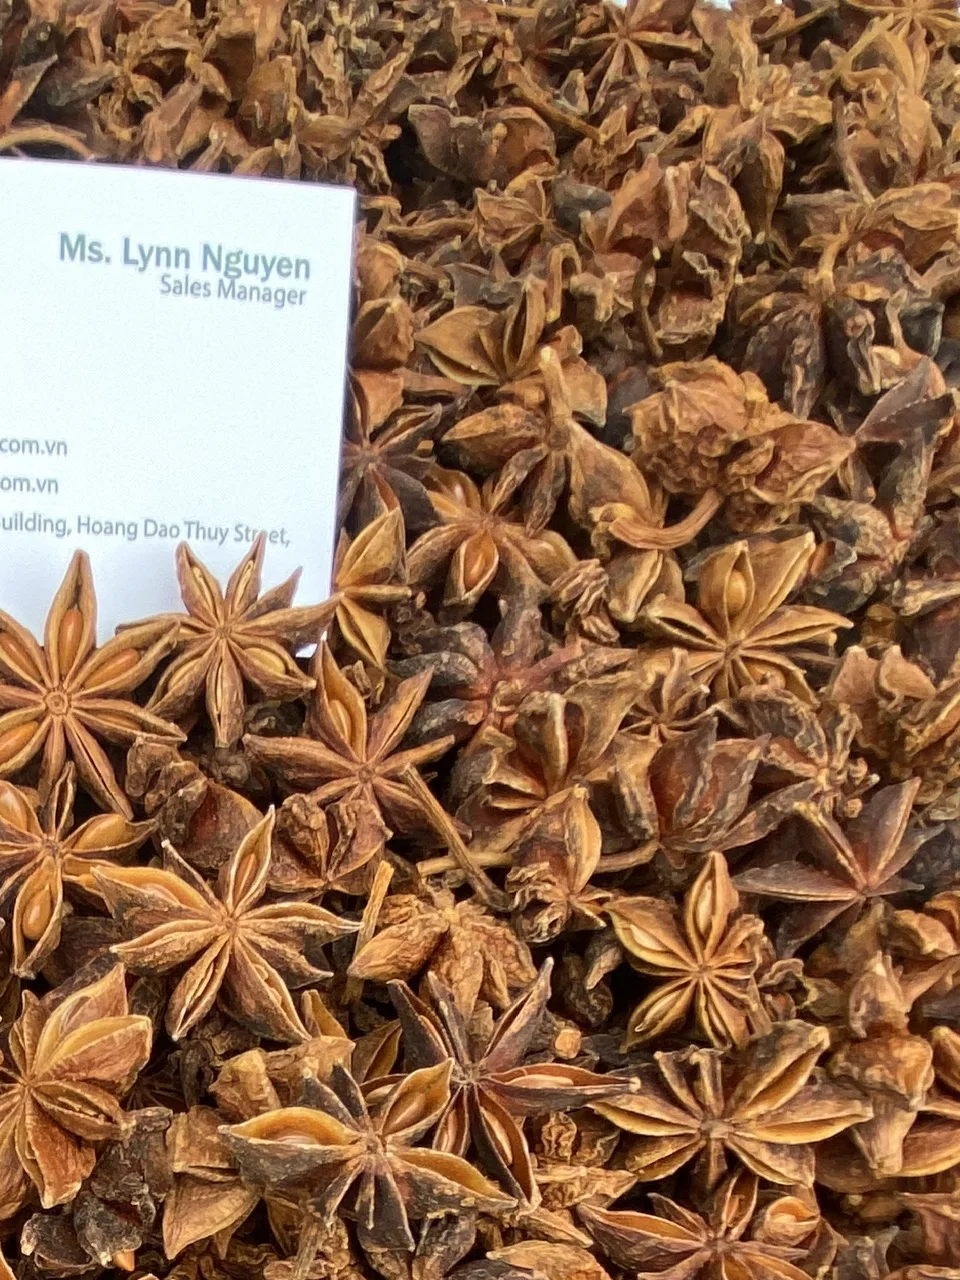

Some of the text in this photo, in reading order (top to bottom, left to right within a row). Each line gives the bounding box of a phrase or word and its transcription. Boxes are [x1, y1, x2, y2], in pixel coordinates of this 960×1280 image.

[59, 231, 310, 282] Ms. Lynn Nguyen
[160, 273, 307, 309] Sales Manager
[77, 515, 138, 541] Hoang
[144, 518, 180, 538] Dao
[184, 520, 230, 547] Thuy
[233, 523, 291, 549] Stret,
